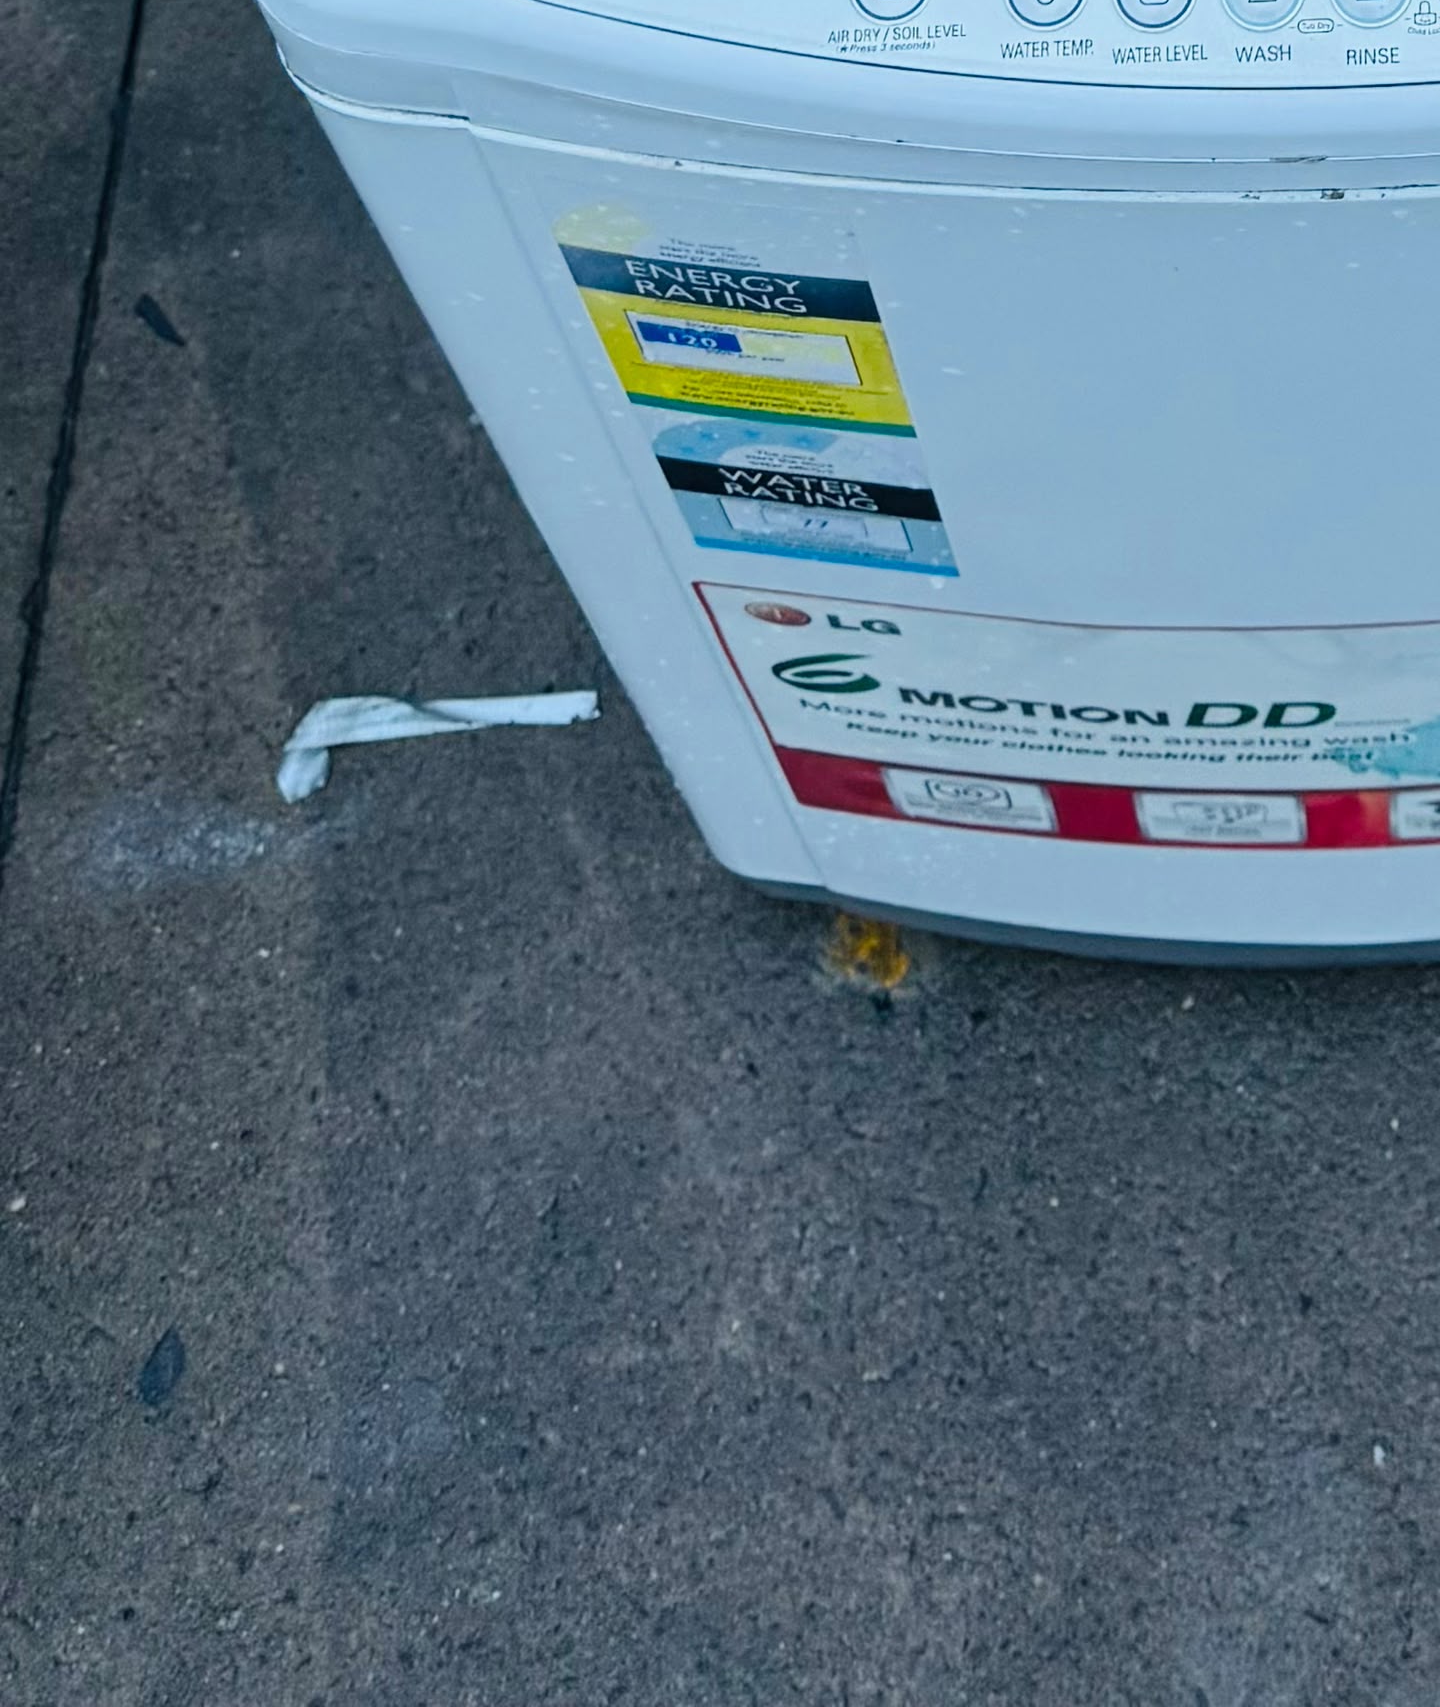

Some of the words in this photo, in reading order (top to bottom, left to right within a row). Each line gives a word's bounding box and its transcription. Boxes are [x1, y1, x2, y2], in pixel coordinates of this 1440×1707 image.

[828, 30, 850, 44] AIR
[854, 28, 880, 43] DRY
[892, 26, 922, 41] SOIL
[927, 24, 967, 39] LEVEL
[1000, 40, 1050, 60] WATER
[1053, 38, 1094, 57] TEMP.
[1112, 45, 1162, 65] WATER
[1165, 44, 1208, 63] LEVEL
[1235, 43, 1293, 63] WASH
[1345, 46, 1400, 66] RINSE
[624, 259, 801, 295] ENERGY
[634, 279, 808, 314] RATING
[718, 467, 869, 497] WATER
[723, 482, 879, 511] RATING
[826, 613, 903, 636] LG
[899, 687, 1170, 726] MOTION
[1186, 702, 1337, 728] DD
[799, 698, 887, 719] More
[900, 714, 1038, 737] motions
[1050, 726, 1094, 740] for
[1110, 733, 1151, 743] an
[1164, 735, 1311, 748] amazing
[1323, 732, 1411, 746] wash
[846, 721, 918, 739] Keep
[928, 732, 994, 747] your
[1002, 740, 1107, 756] clothes
[1117, 749, 1226, 763] looking
[1234, 750, 1299, 762] their
[1310, 750, 1375, 763] best
